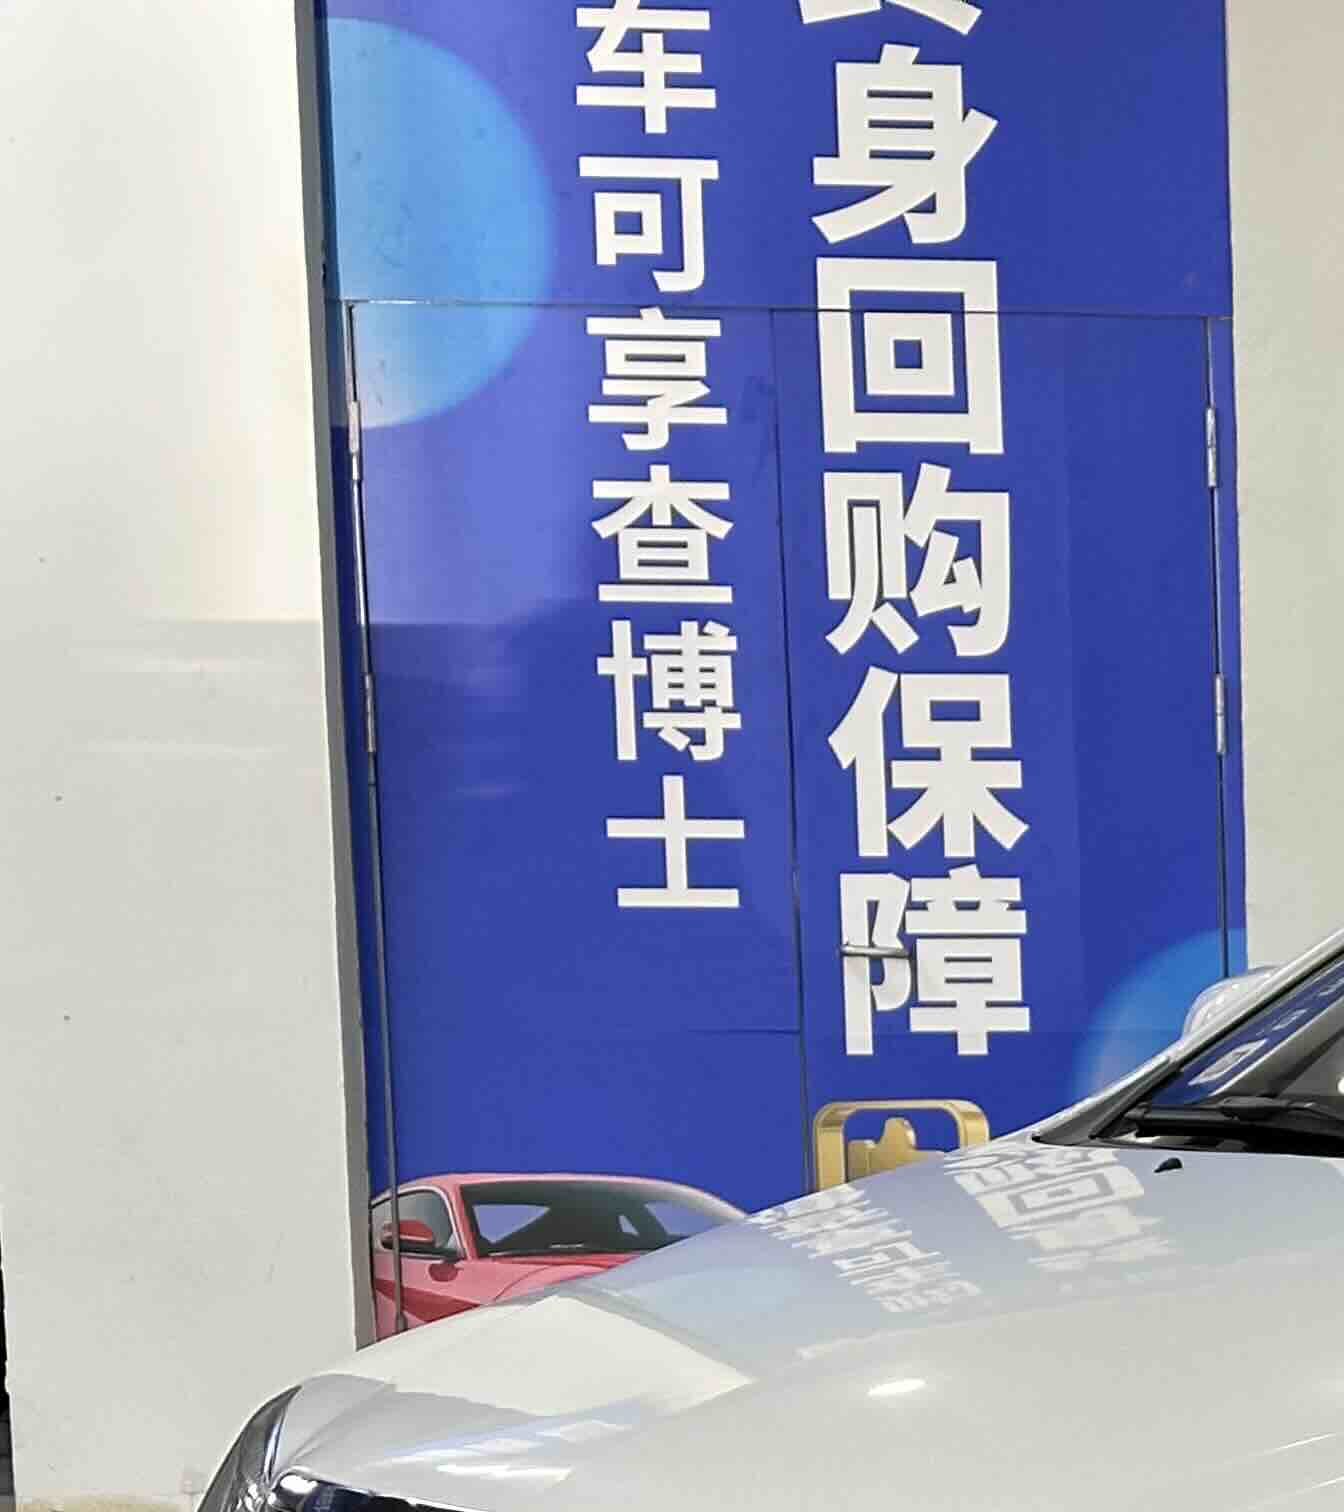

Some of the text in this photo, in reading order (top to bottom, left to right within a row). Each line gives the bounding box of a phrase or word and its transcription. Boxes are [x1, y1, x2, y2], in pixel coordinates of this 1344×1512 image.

[574, 0, 745, 908] 车可享查博士
[798, 0, 1030, 1056] 身回购保障
